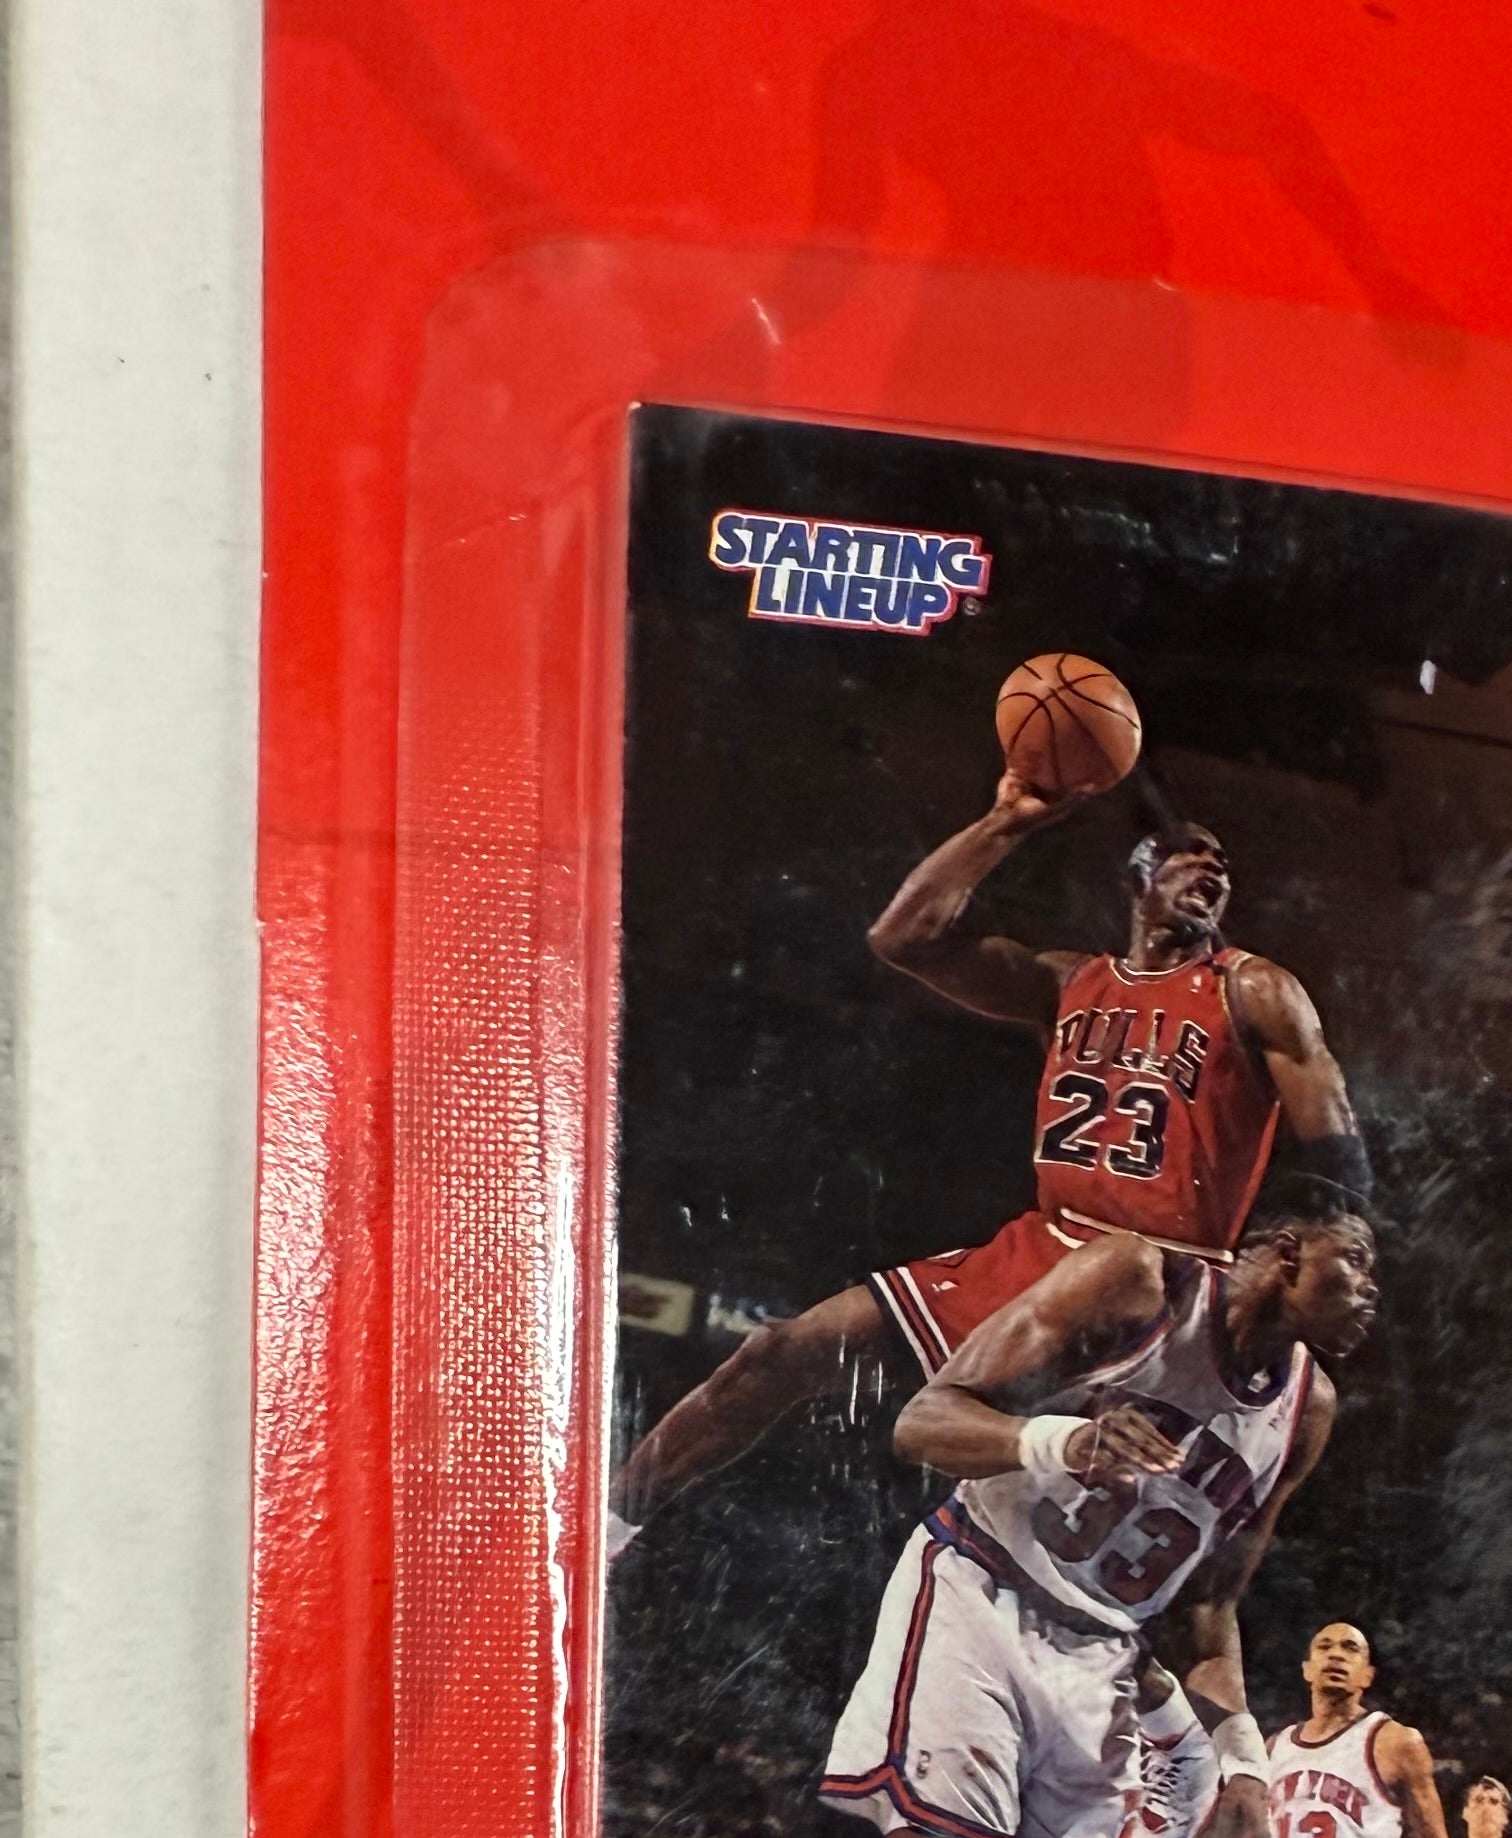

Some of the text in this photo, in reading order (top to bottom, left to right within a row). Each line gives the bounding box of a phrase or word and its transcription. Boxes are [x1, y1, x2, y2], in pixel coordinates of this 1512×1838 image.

[711, 512, 986, 589] STARTING
[753, 563, 952, 629] LINEUP
[1035, 1070, 1171, 1181] 23
